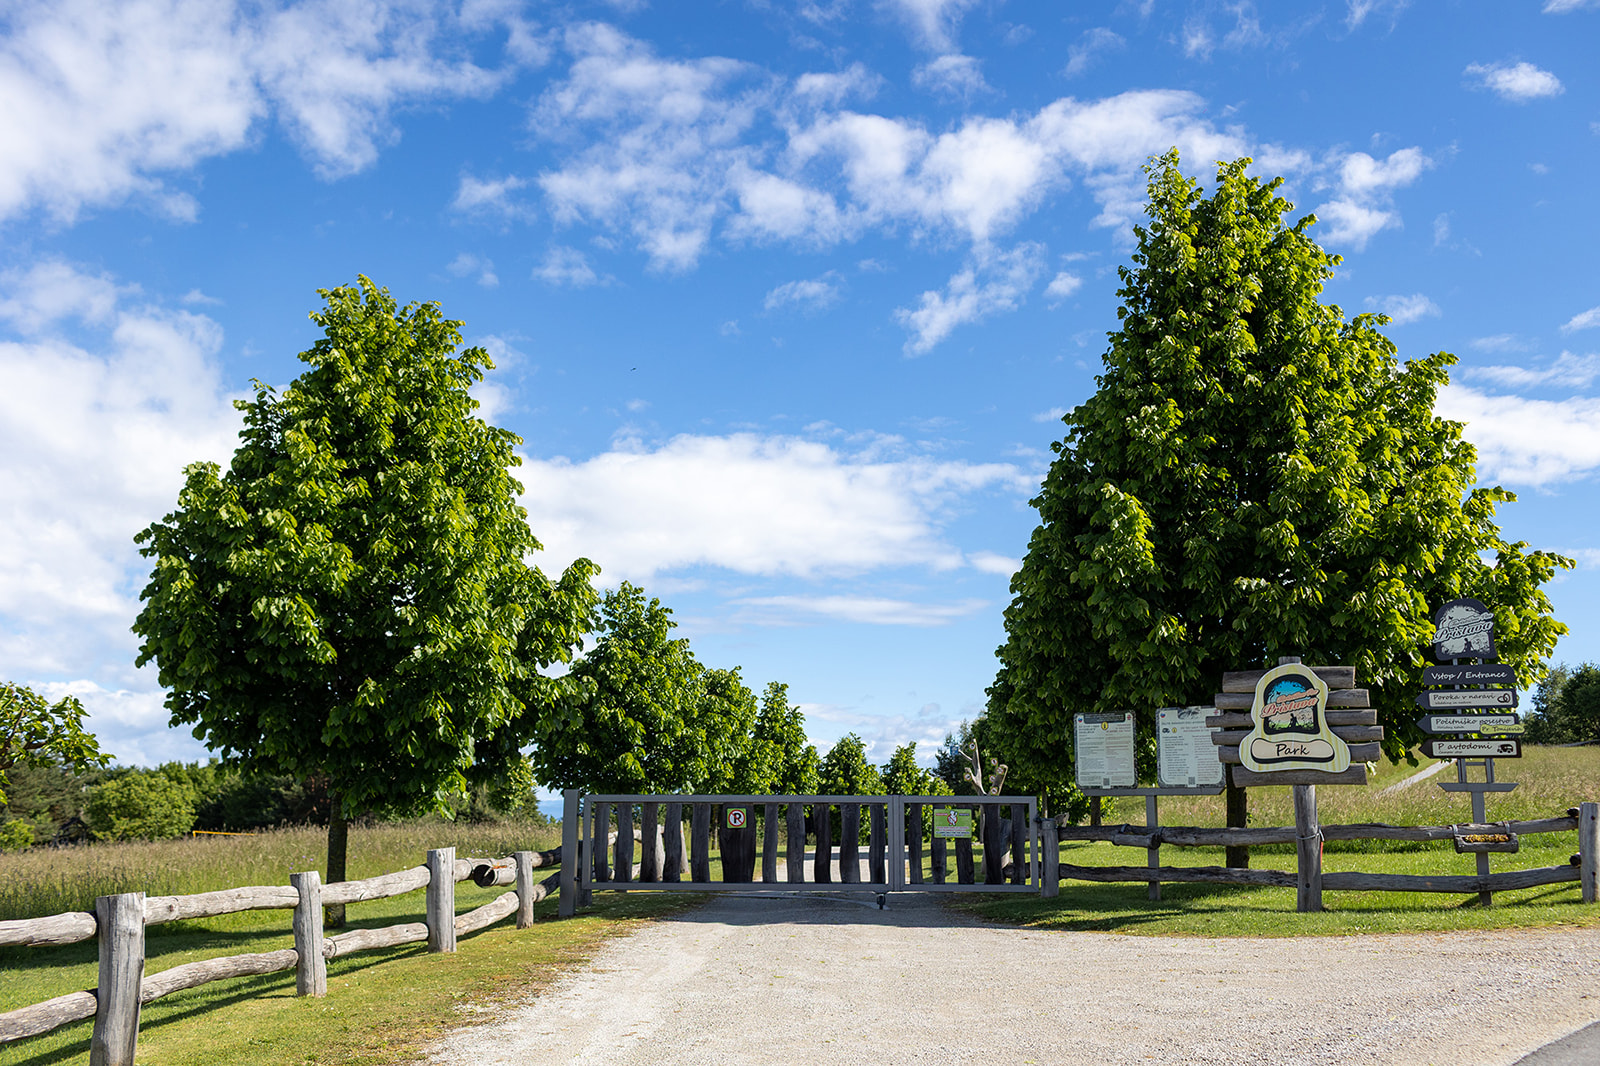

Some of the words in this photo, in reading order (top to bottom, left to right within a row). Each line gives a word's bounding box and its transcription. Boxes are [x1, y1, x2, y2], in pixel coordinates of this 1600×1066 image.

[1434, 622, 1492, 641] Pristava
[1431, 672, 1456, 681] Vstop
[1456, 671, 1463, 680] /
[1465, 671, 1508, 679] Entrance
[1469, 692, 1496, 700] naravi
[1262, 697, 1317, 716] Pristava
[1275, 743, 1310, 757] Park
[1447, 742, 1492, 750] avtodomi
